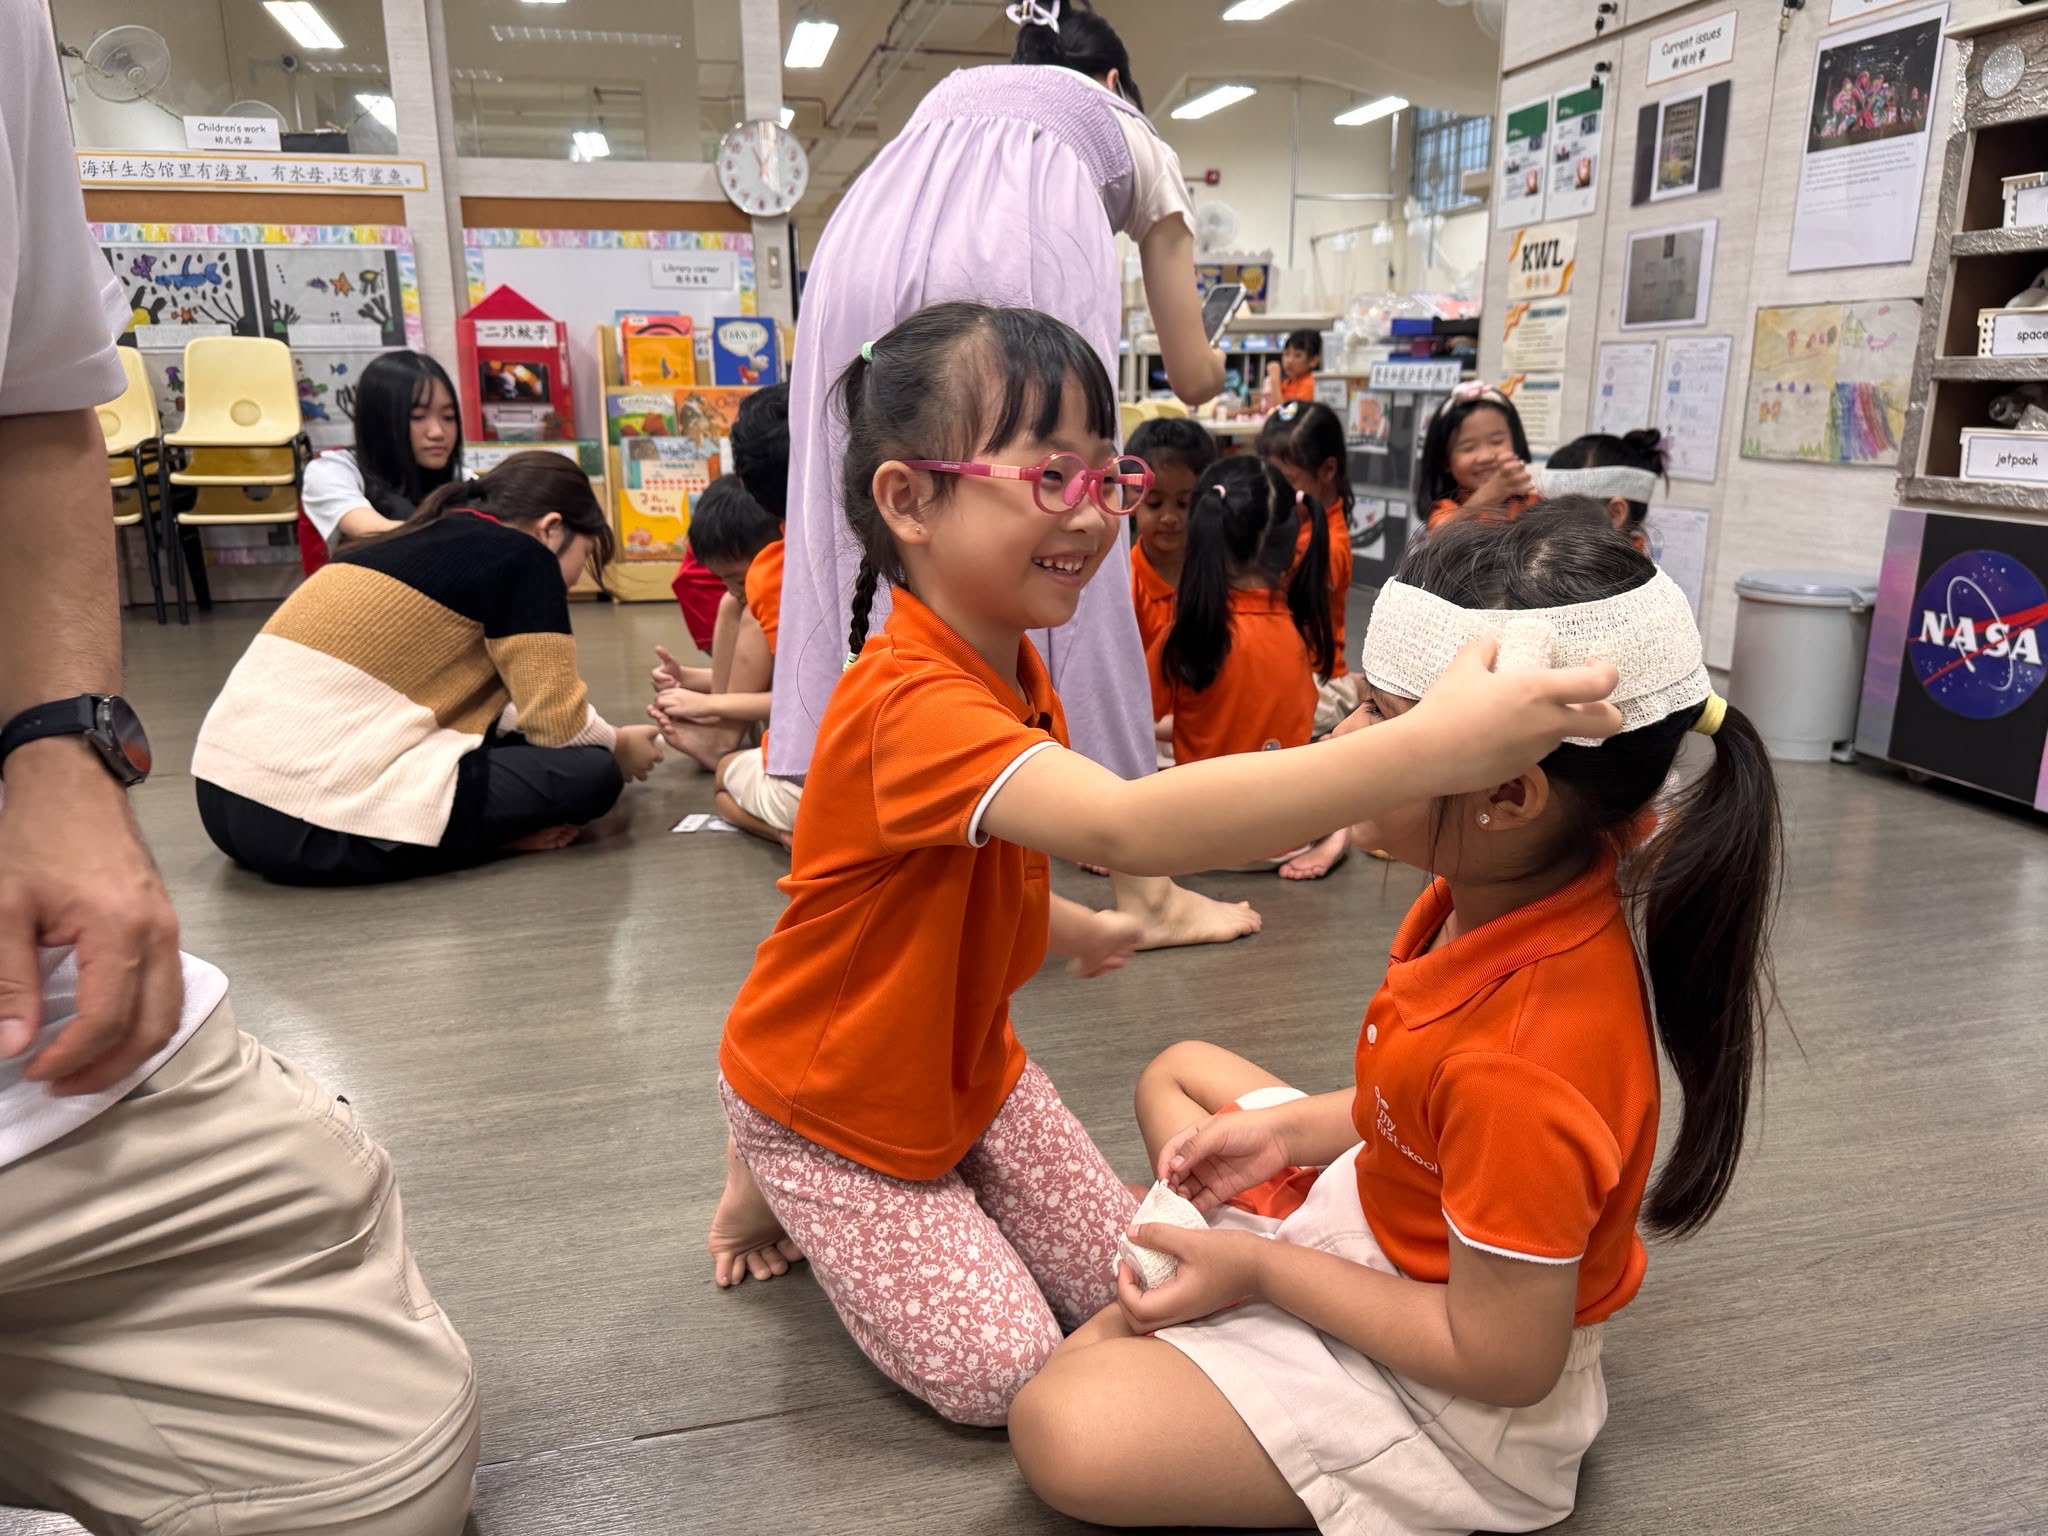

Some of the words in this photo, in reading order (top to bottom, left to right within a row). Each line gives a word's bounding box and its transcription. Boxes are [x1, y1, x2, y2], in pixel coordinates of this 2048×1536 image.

[1661, 36, 1694, 56] Current
[1695, 27, 1721, 44] issues
[197, 122, 242, 134] Children's
[244, 124, 267, 134] work
[1521, 239, 1564, 272] KWL
[1996, 452, 2038, 468] jetpack
[1919, 610, 2042, 665] NASA
[1400, 1144, 1438, 1173] skool
